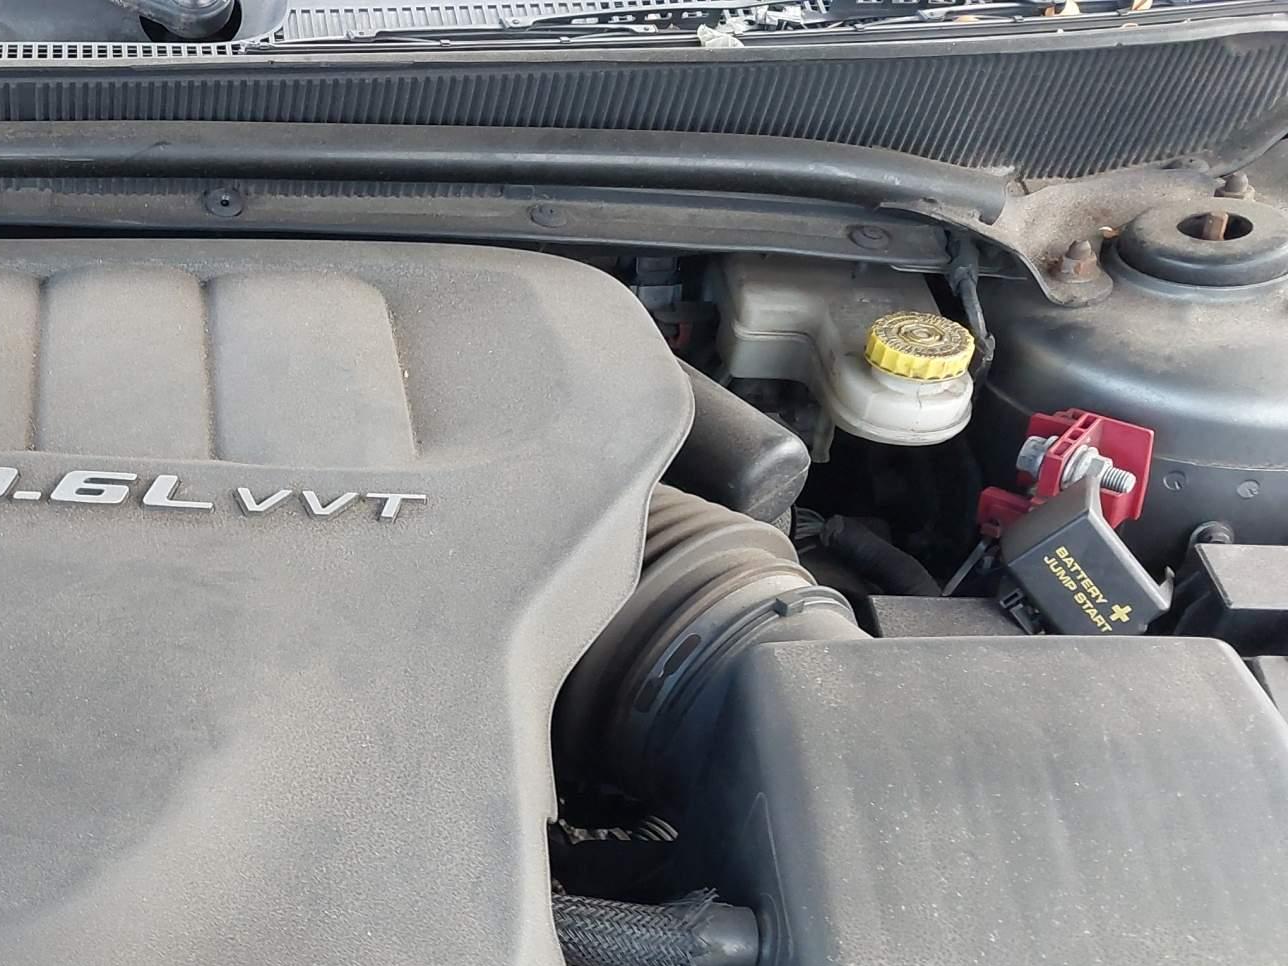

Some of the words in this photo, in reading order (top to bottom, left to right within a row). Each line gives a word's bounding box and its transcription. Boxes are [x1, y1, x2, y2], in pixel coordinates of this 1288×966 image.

[236, 486, 429, 523] VVT
[1043, 555, 1078, 592] JUMP
[1073, 593, 1113, 633] START
[1054, 546, 1108, 604] BATTERY
